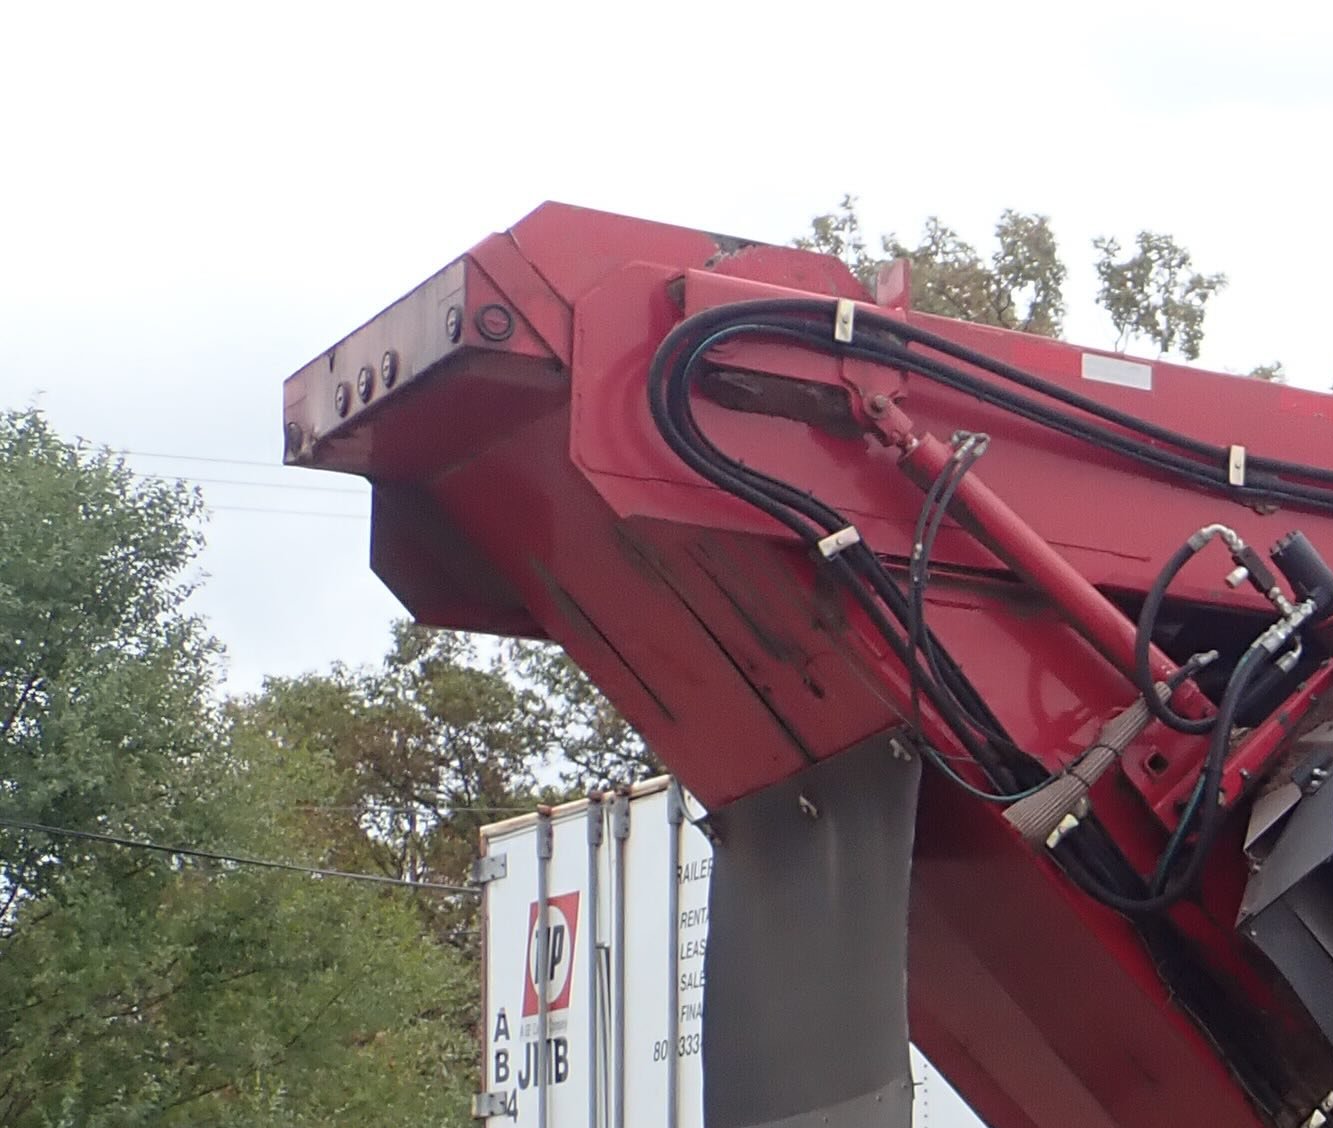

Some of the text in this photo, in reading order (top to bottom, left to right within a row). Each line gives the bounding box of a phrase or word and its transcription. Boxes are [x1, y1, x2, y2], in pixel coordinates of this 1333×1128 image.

[677, 857, 713, 885] RAILER
[680, 939, 706, 960] LEAS
[680, 1005, 702, 1023] FINA
